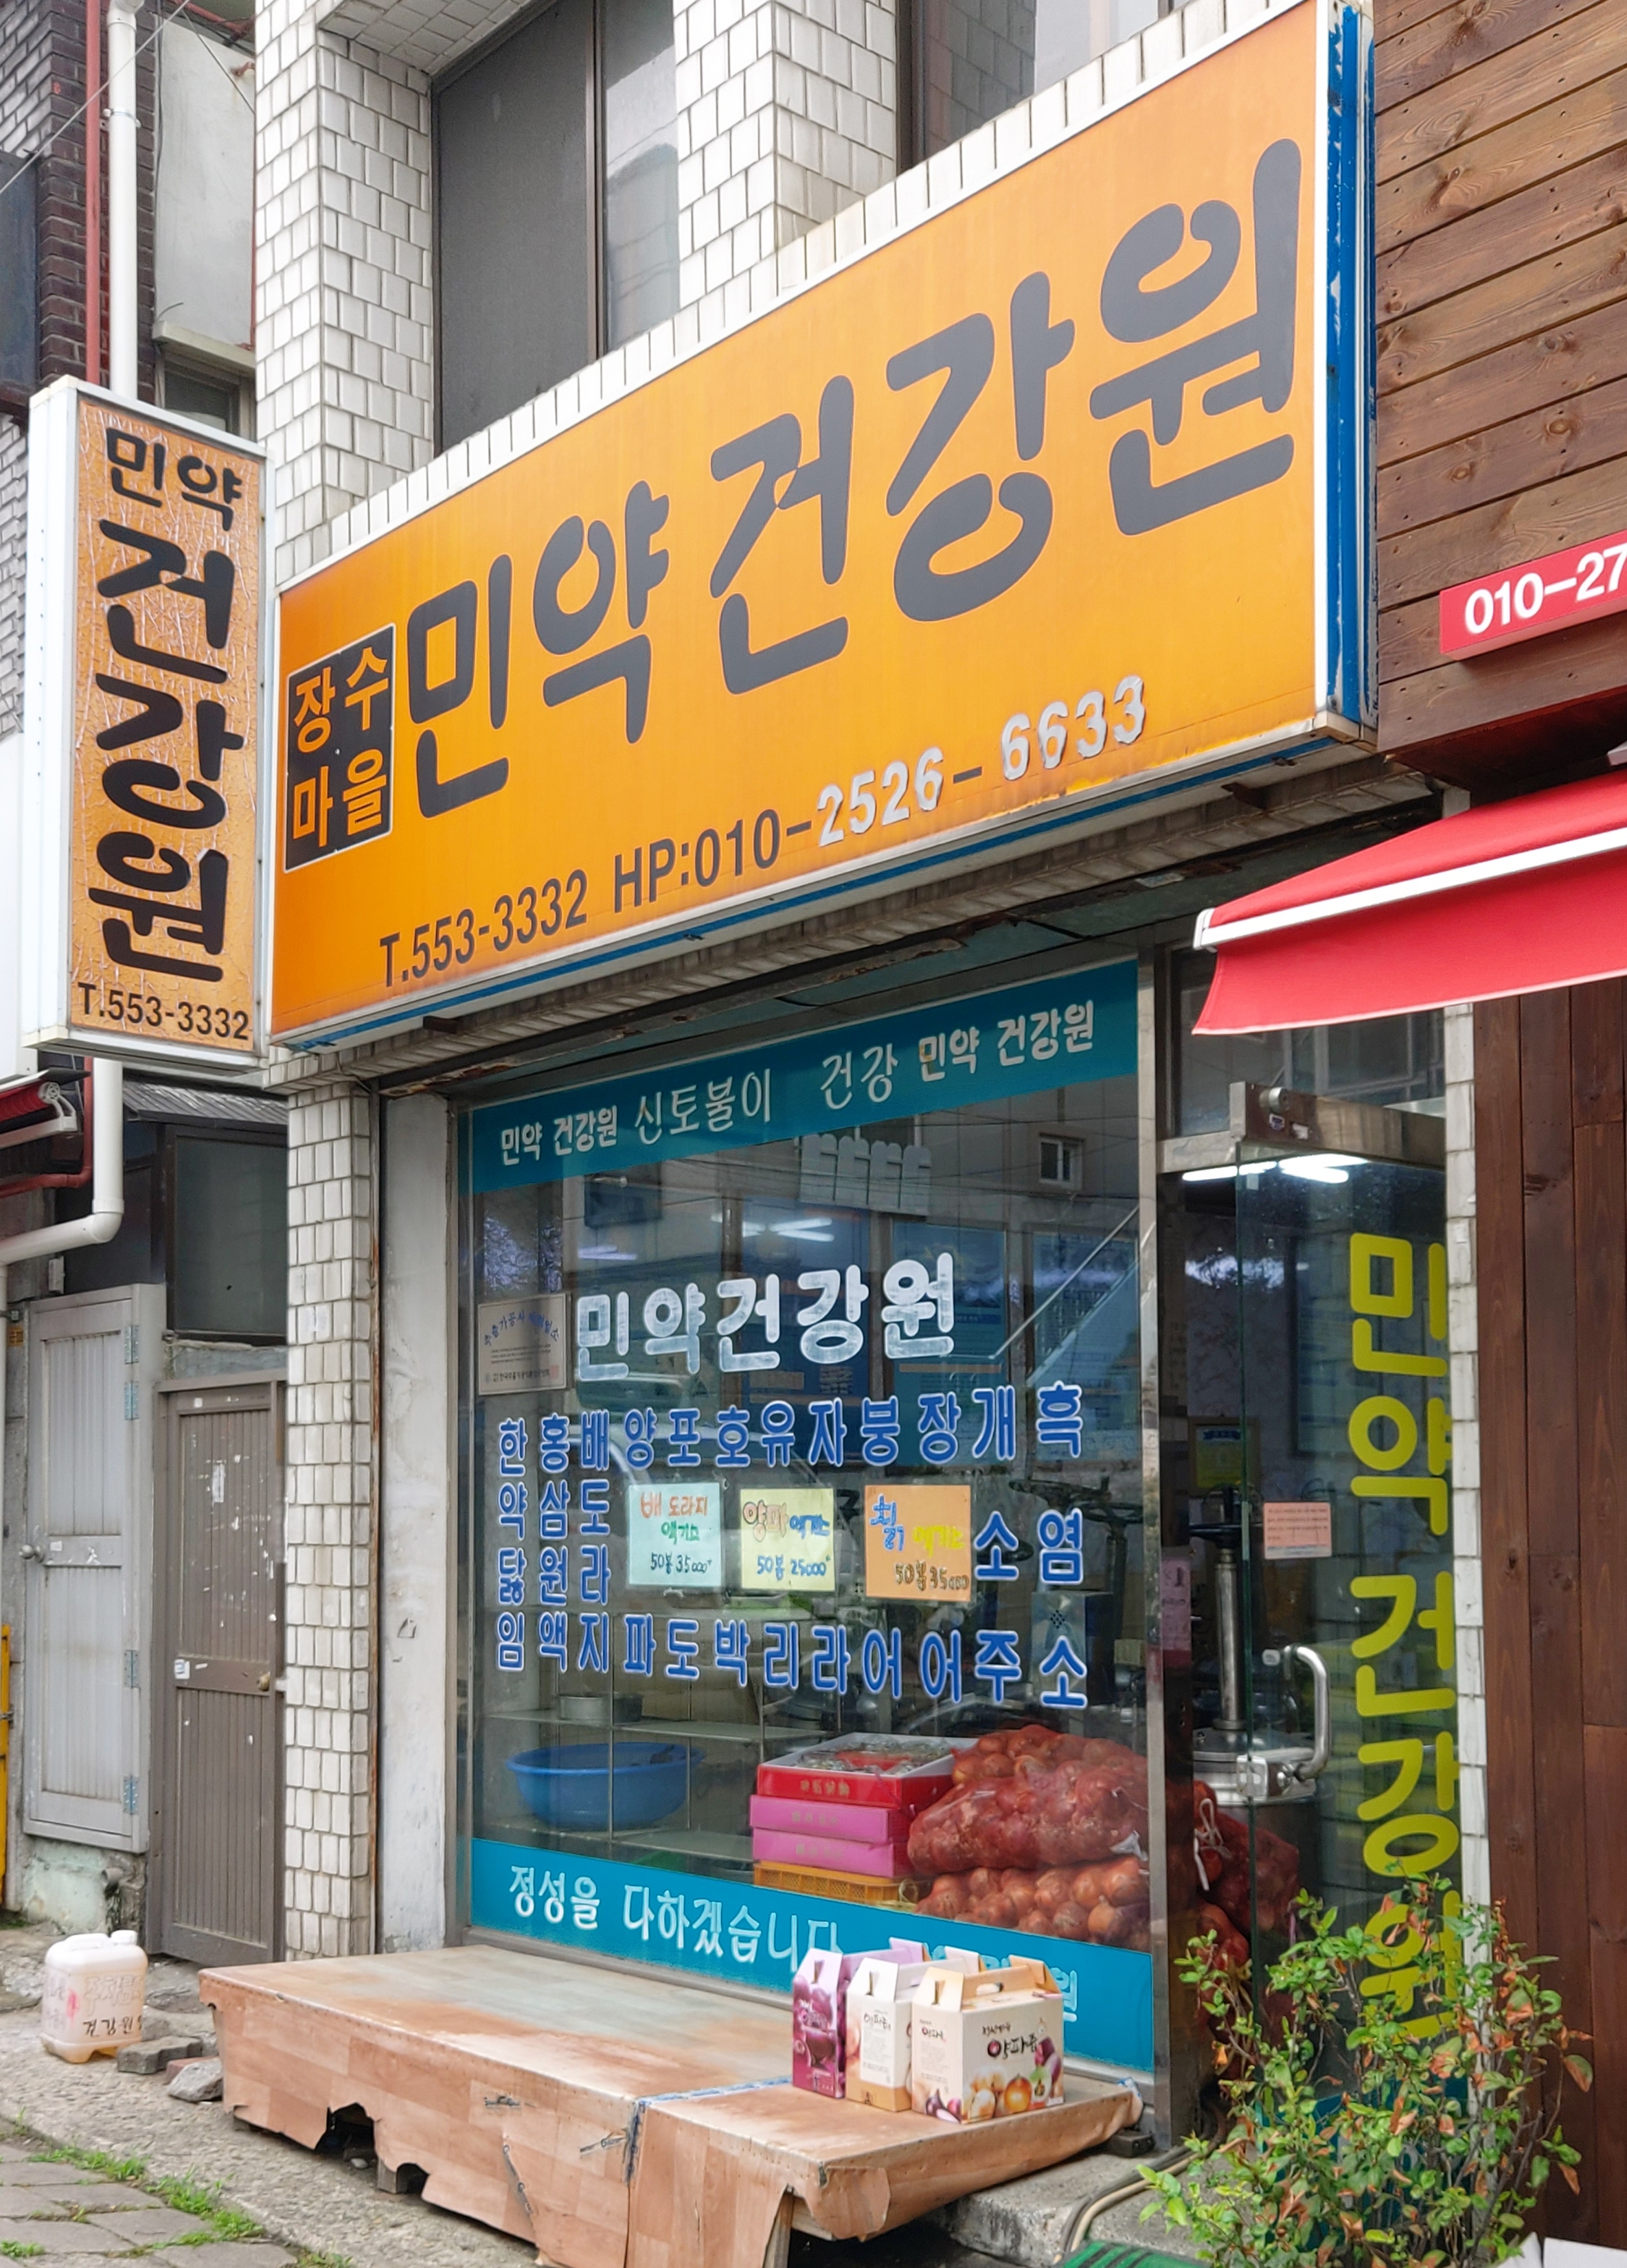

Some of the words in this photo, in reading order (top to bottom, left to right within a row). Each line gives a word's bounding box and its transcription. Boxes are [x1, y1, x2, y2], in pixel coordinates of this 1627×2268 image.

[106, 427, 242, 531] 민약
[407, 480, 670, 820] 민약
[710, 138, 1302, 695] 건강원
[89, 518, 244, 982] 건강원
[293, 646, 389, 755] 장수
[293, 749, 388, 847] 마을
[379, 869, 589, 987] T.553-3332
[78, 983, 249, 1040] T.553-3332
[501, 1122, 543, 1166] 민약
[553, 1105, 618, 1156] 건강원
[635, 1068, 772, 1145] 신토불이
[822, 1043, 899, 1110] 건강
[918, 1027, 979, 1083] 민약
[997, 999, 1095, 1068] 건강원
[576, 1250, 956, 1383] 민약건강원
[1349, 1233, 1453, 1535] 민약
[668, 1496, 707, 1517] 도라지
[742, 1499, 789, 1543] 양파
[508, 1864, 600, 1929] 정성을
